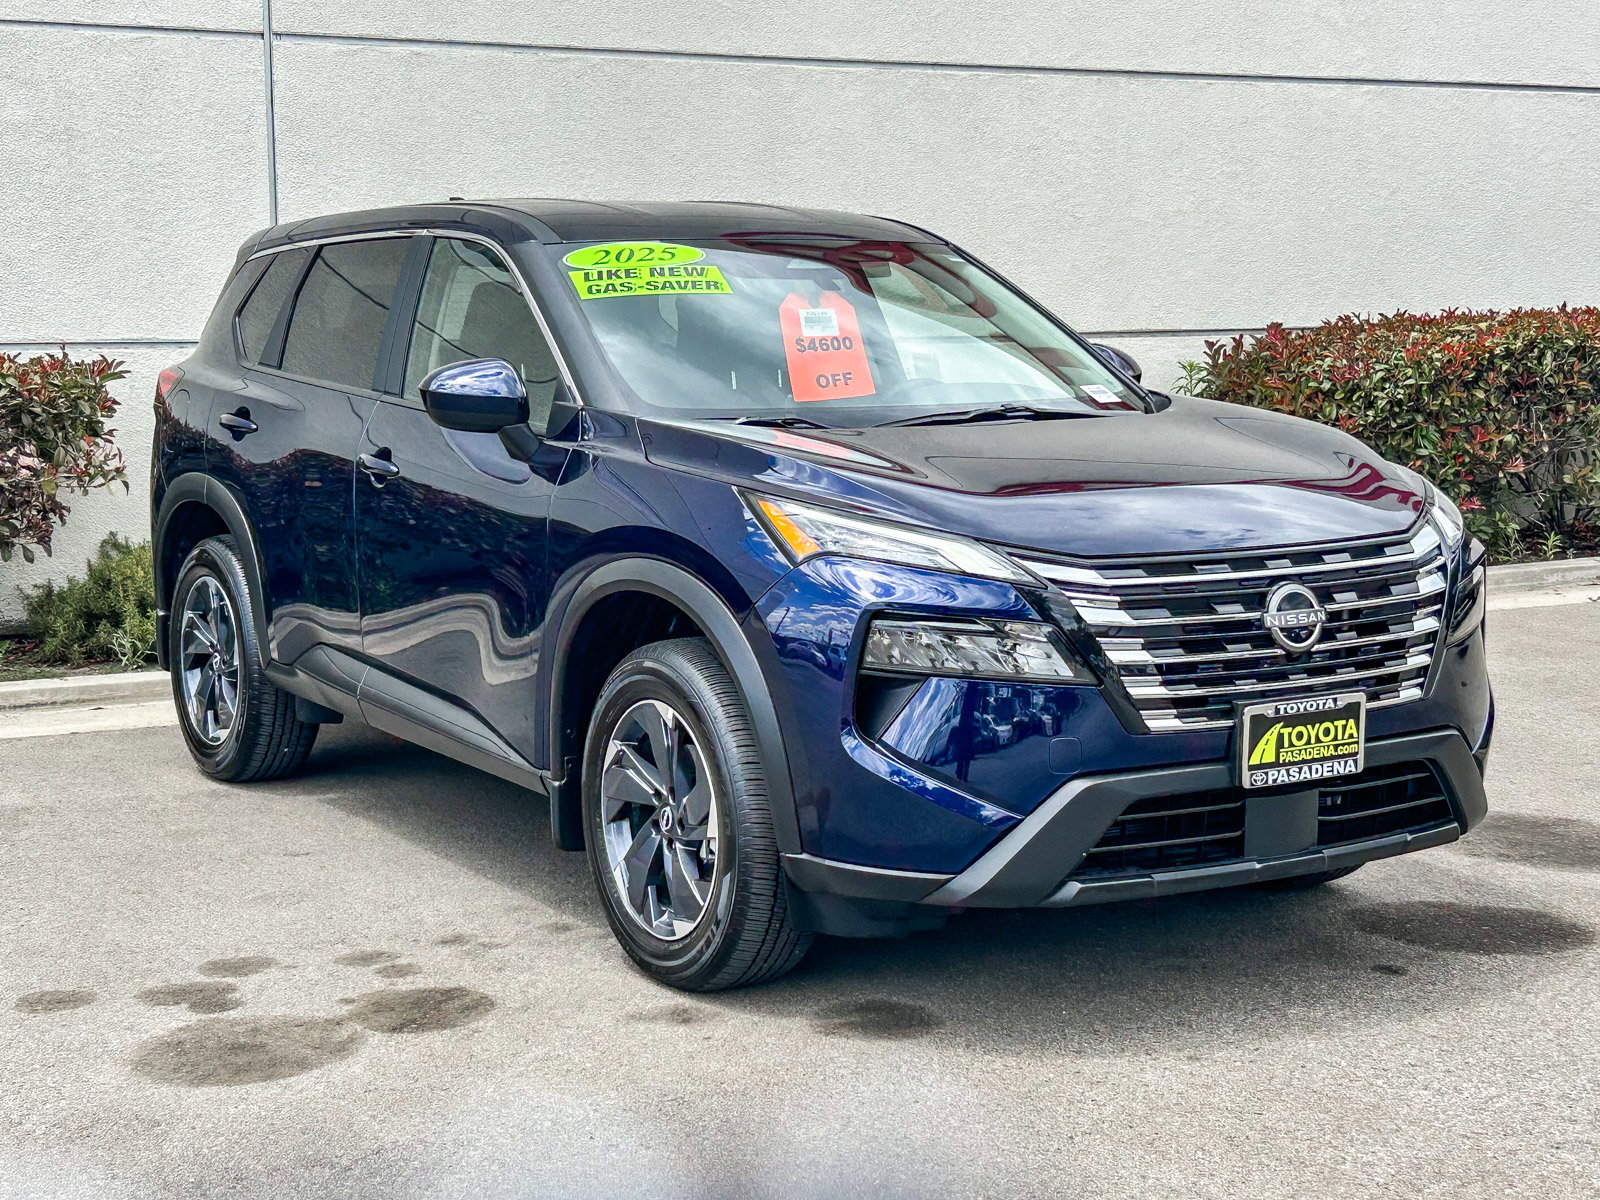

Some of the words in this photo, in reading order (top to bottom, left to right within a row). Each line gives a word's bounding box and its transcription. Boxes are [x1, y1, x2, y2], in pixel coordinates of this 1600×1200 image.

[592, 246, 677, 266] 2025
[584, 268, 638, 282] LIKE
[650, 266, 706, 278] NEW
[587, 280, 720, 295] GAS-SAVER
[796, 336, 853, 353] $4600
[816, 372, 852, 388] OFF
[1266, 610, 1326, 626] NISSAN
[1277, 698, 1335, 715] TOYOTA
[1279, 718, 1358, 748] TOYOTA
[1279, 743, 1358, 764] PASADENA.com
[1267, 759, 1357, 785] PASADENA
